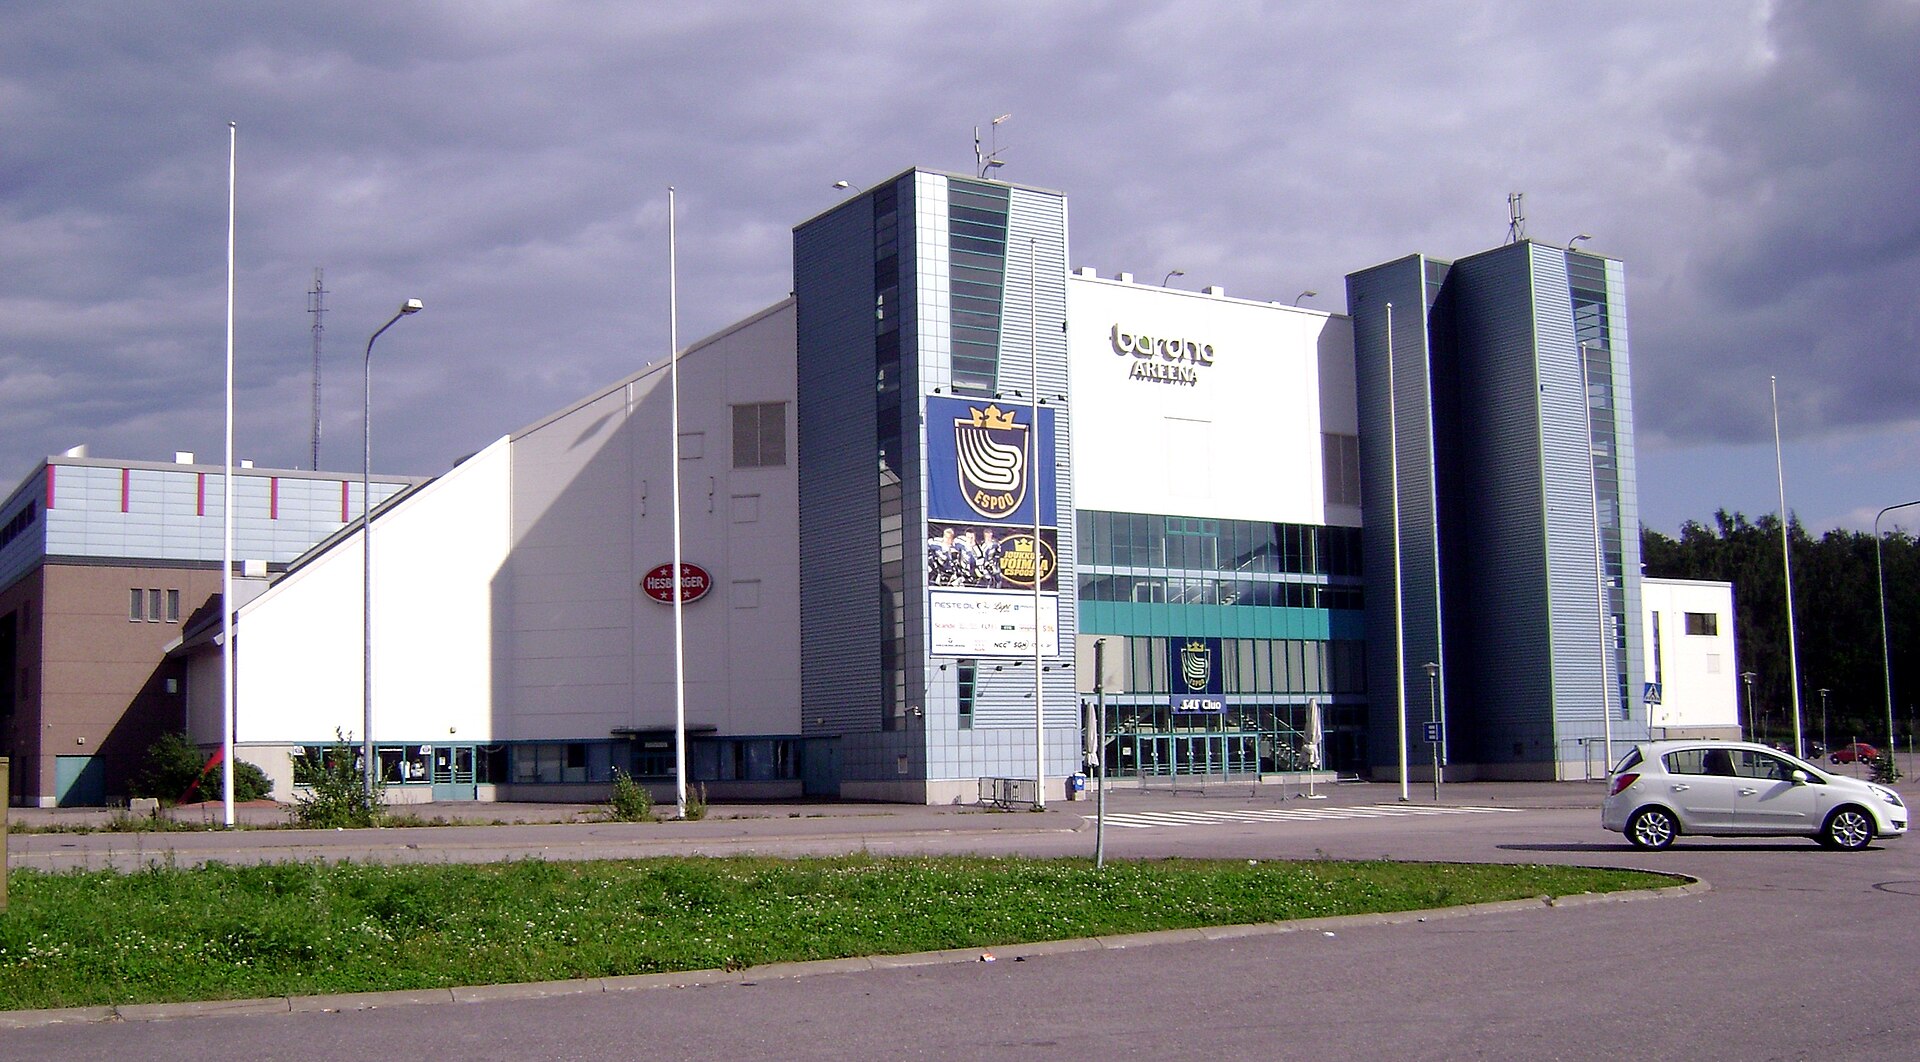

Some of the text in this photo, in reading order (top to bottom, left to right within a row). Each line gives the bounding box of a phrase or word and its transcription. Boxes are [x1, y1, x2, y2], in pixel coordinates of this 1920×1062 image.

[1111, 322, 1214, 366] barona
[1129, 360, 1197, 386] AREENA
[974, 489, 1014, 510] ESPOO
[1004, 568, 1044, 577] ESPOOSA
[647, 576, 704, 590] HESBRGER
[1180, 699, 1200, 710] SAS
